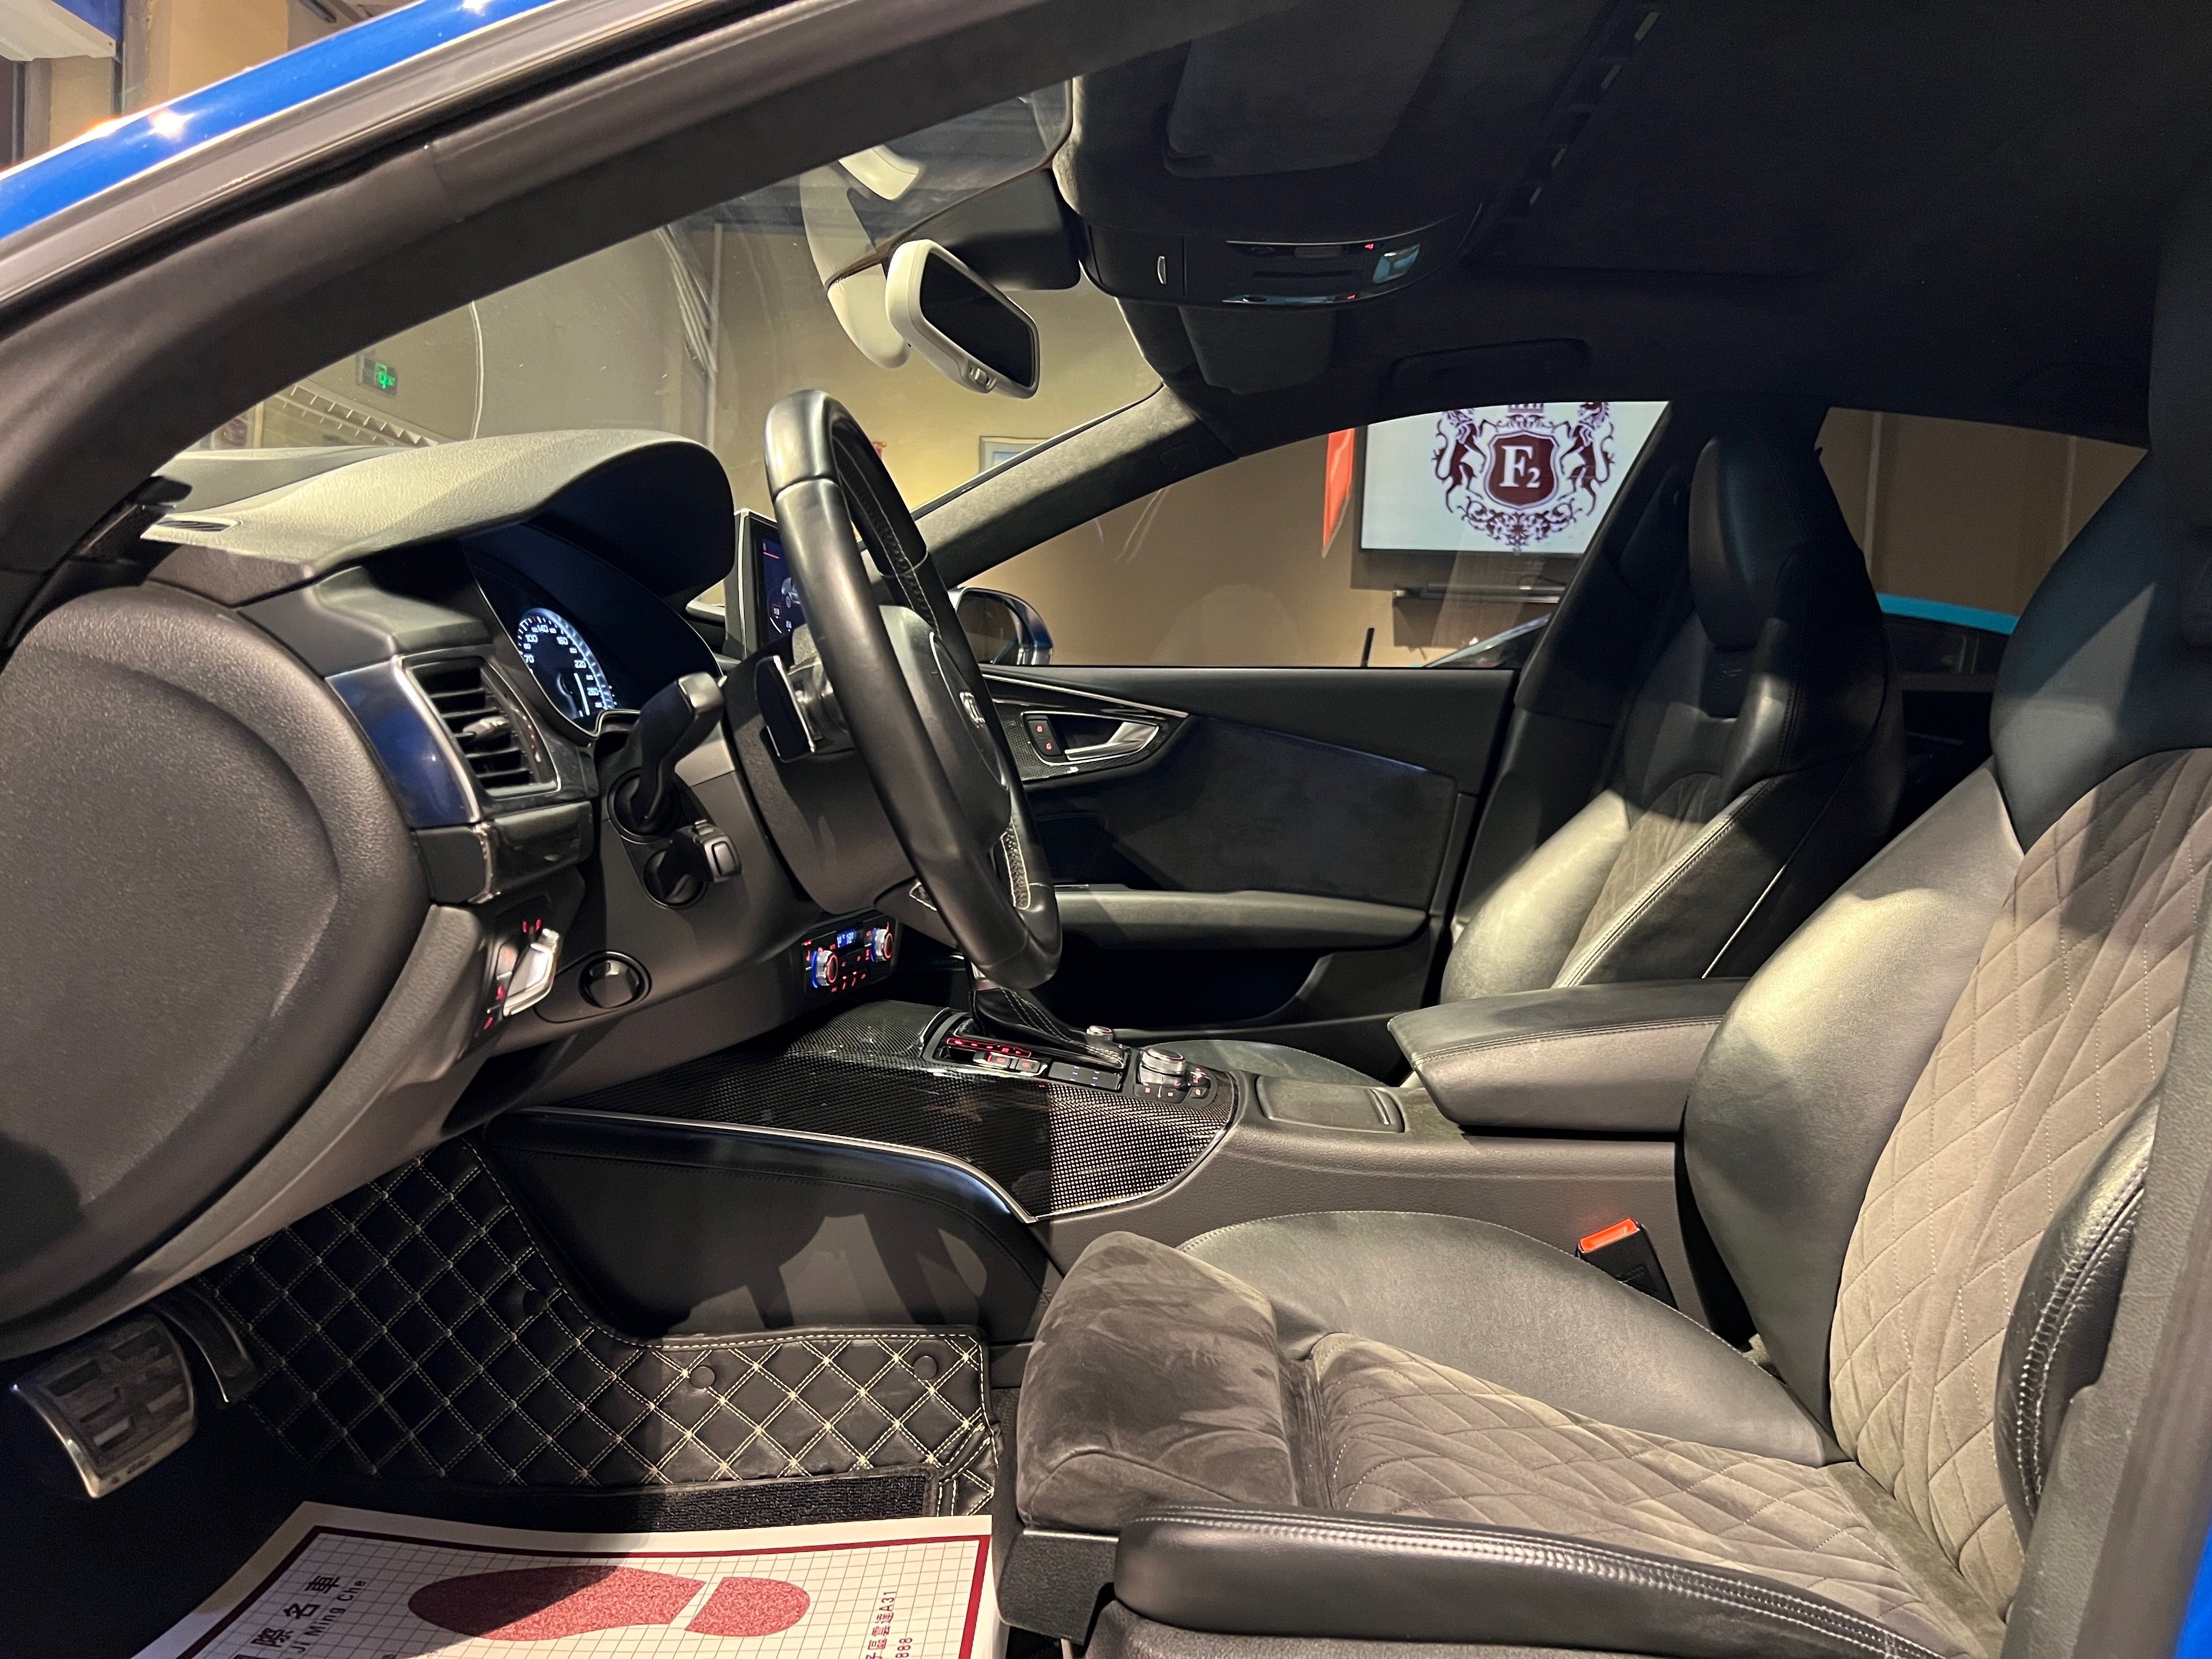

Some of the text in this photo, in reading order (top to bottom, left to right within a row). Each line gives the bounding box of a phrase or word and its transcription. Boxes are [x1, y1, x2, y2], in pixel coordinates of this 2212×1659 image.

[1499, 445, 1541, 488] F2
[523, 654, 535, 663] 70
[304, 1607, 346, 1636] Ming
[337, 1580, 366, 1601] Che
